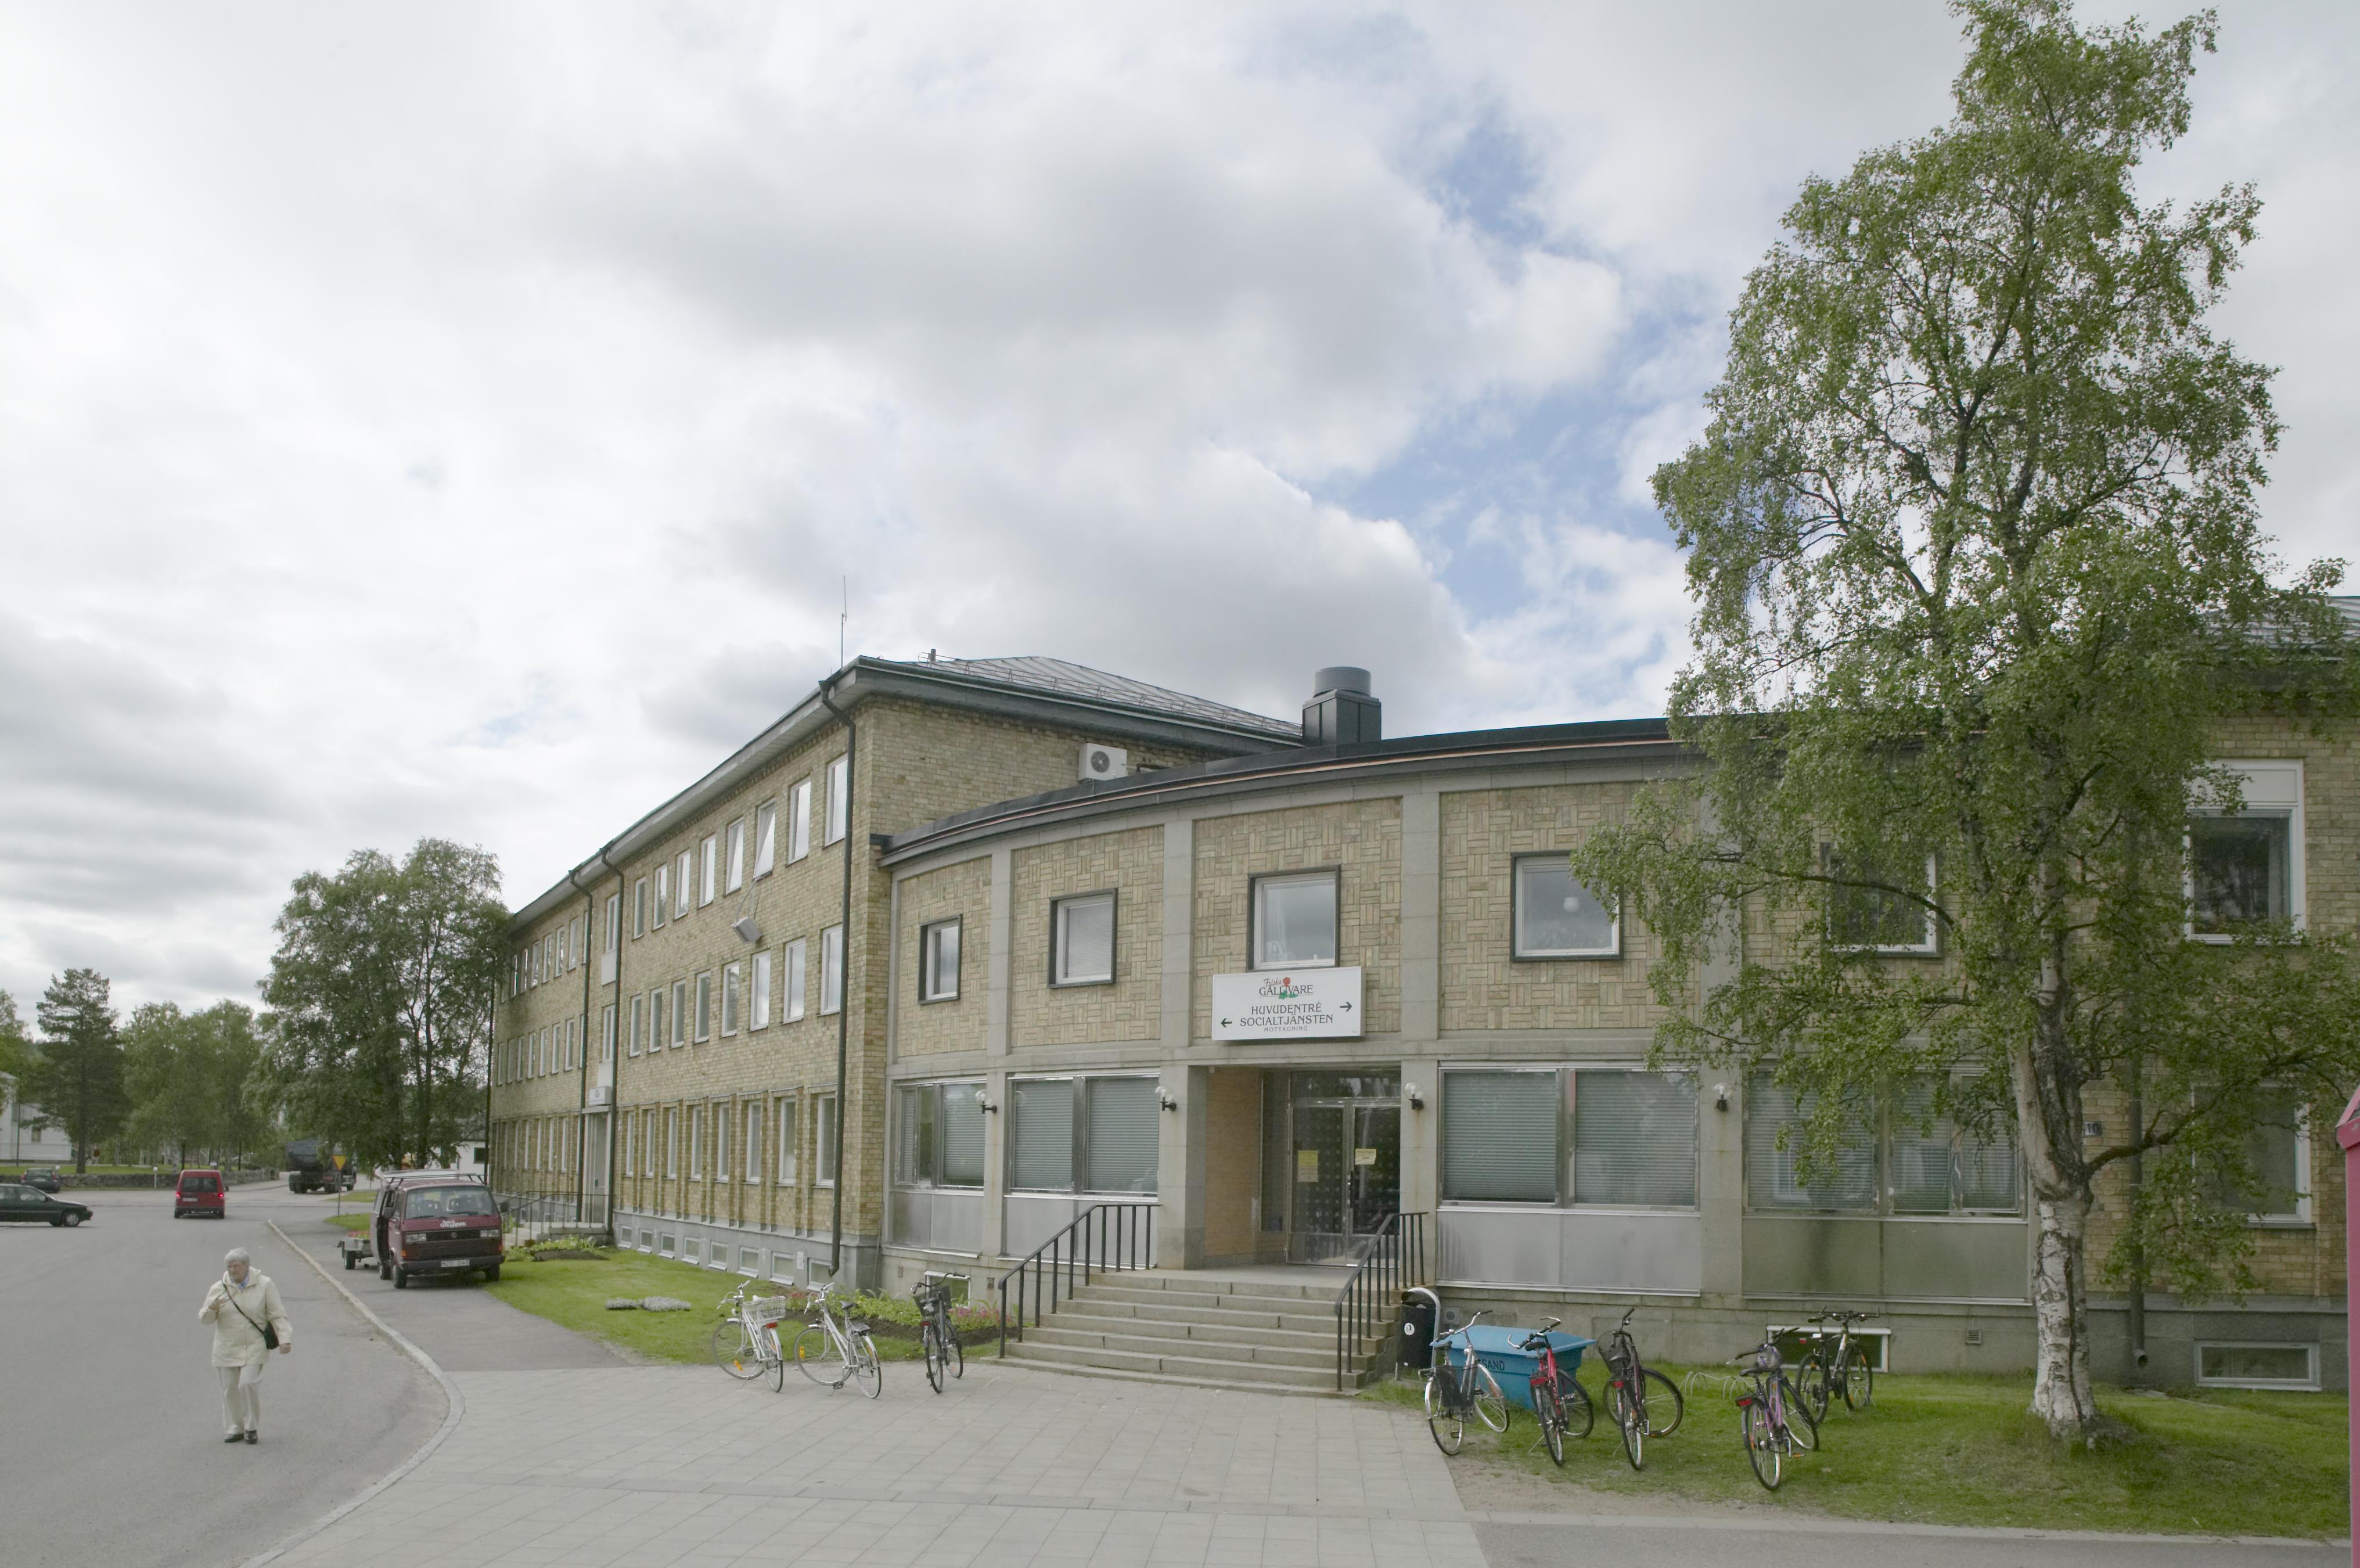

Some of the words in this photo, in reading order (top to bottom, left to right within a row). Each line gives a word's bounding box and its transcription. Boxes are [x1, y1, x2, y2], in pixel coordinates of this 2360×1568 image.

[1264, 977, 1282, 987] Friska
[1251, 1002, 1322, 1015] HUVUDENTRÉ
[1240, 1013, 1333, 1027] SOCIALTJÄNSTEN
[1481, 1359, 1505, 1371] SAND
